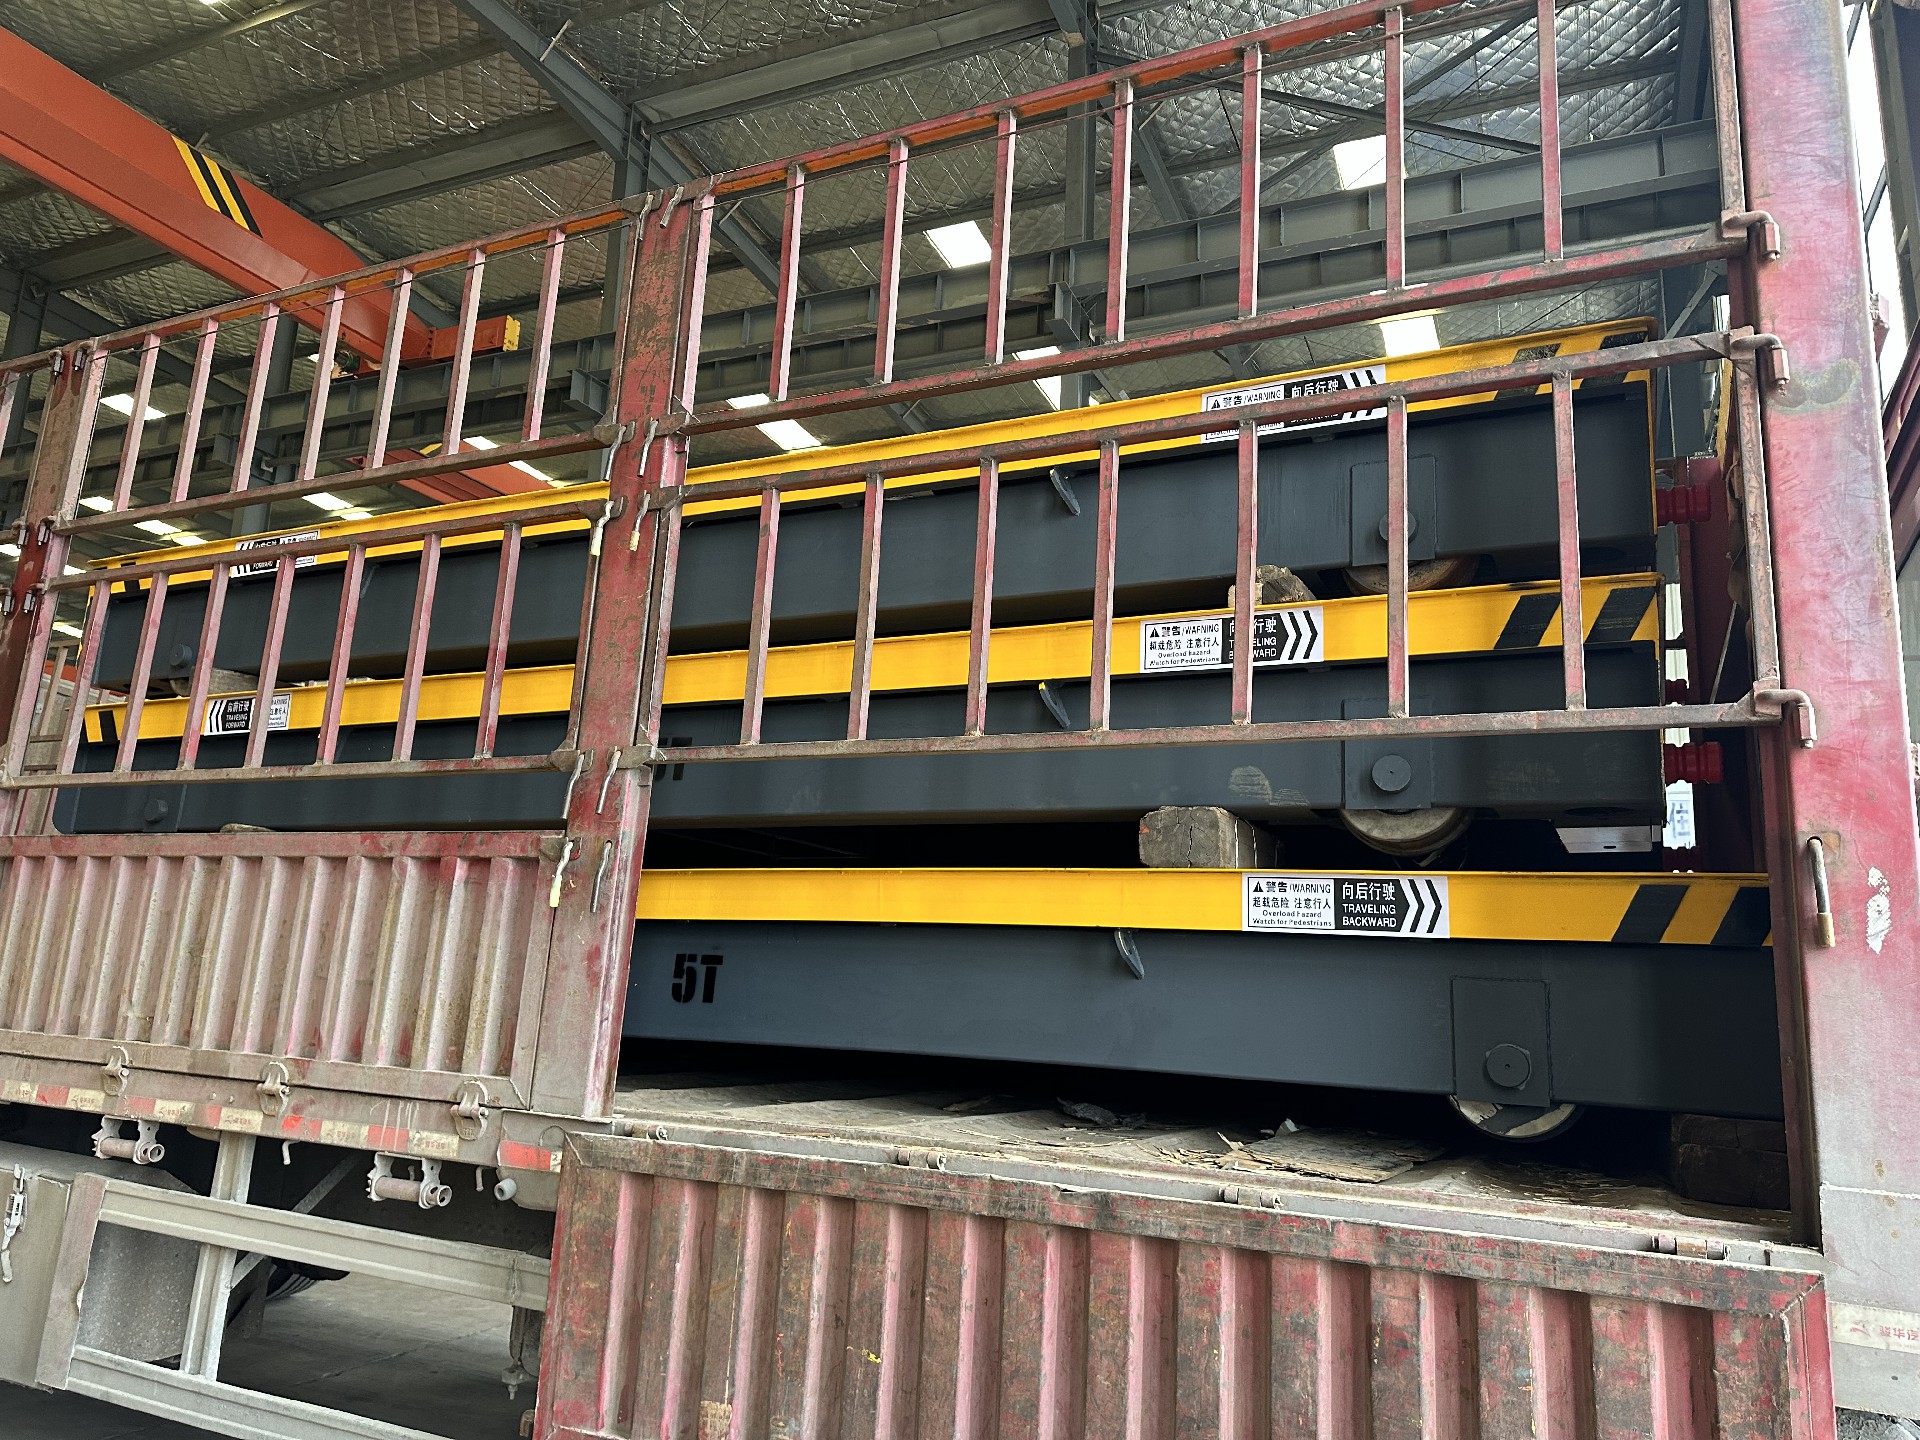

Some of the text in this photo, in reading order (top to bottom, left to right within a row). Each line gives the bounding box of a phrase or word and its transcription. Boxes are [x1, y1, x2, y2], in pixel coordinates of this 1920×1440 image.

[1229, 637, 1277, 649] TELING
[1342, 881, 1396, 901] 向后行驶
[1252, 896, 1332, 910] 超载危险 注意行人
[1341, 903, 1397, 915] TRAVELING
[1262, 909, 1296, 917] Overload
[1252, 917, 1332, 927] Watch for Pedestrians
[1342, 916, 1397, 928] BACKWARD
[671, 953, 724, 1004] 5T
